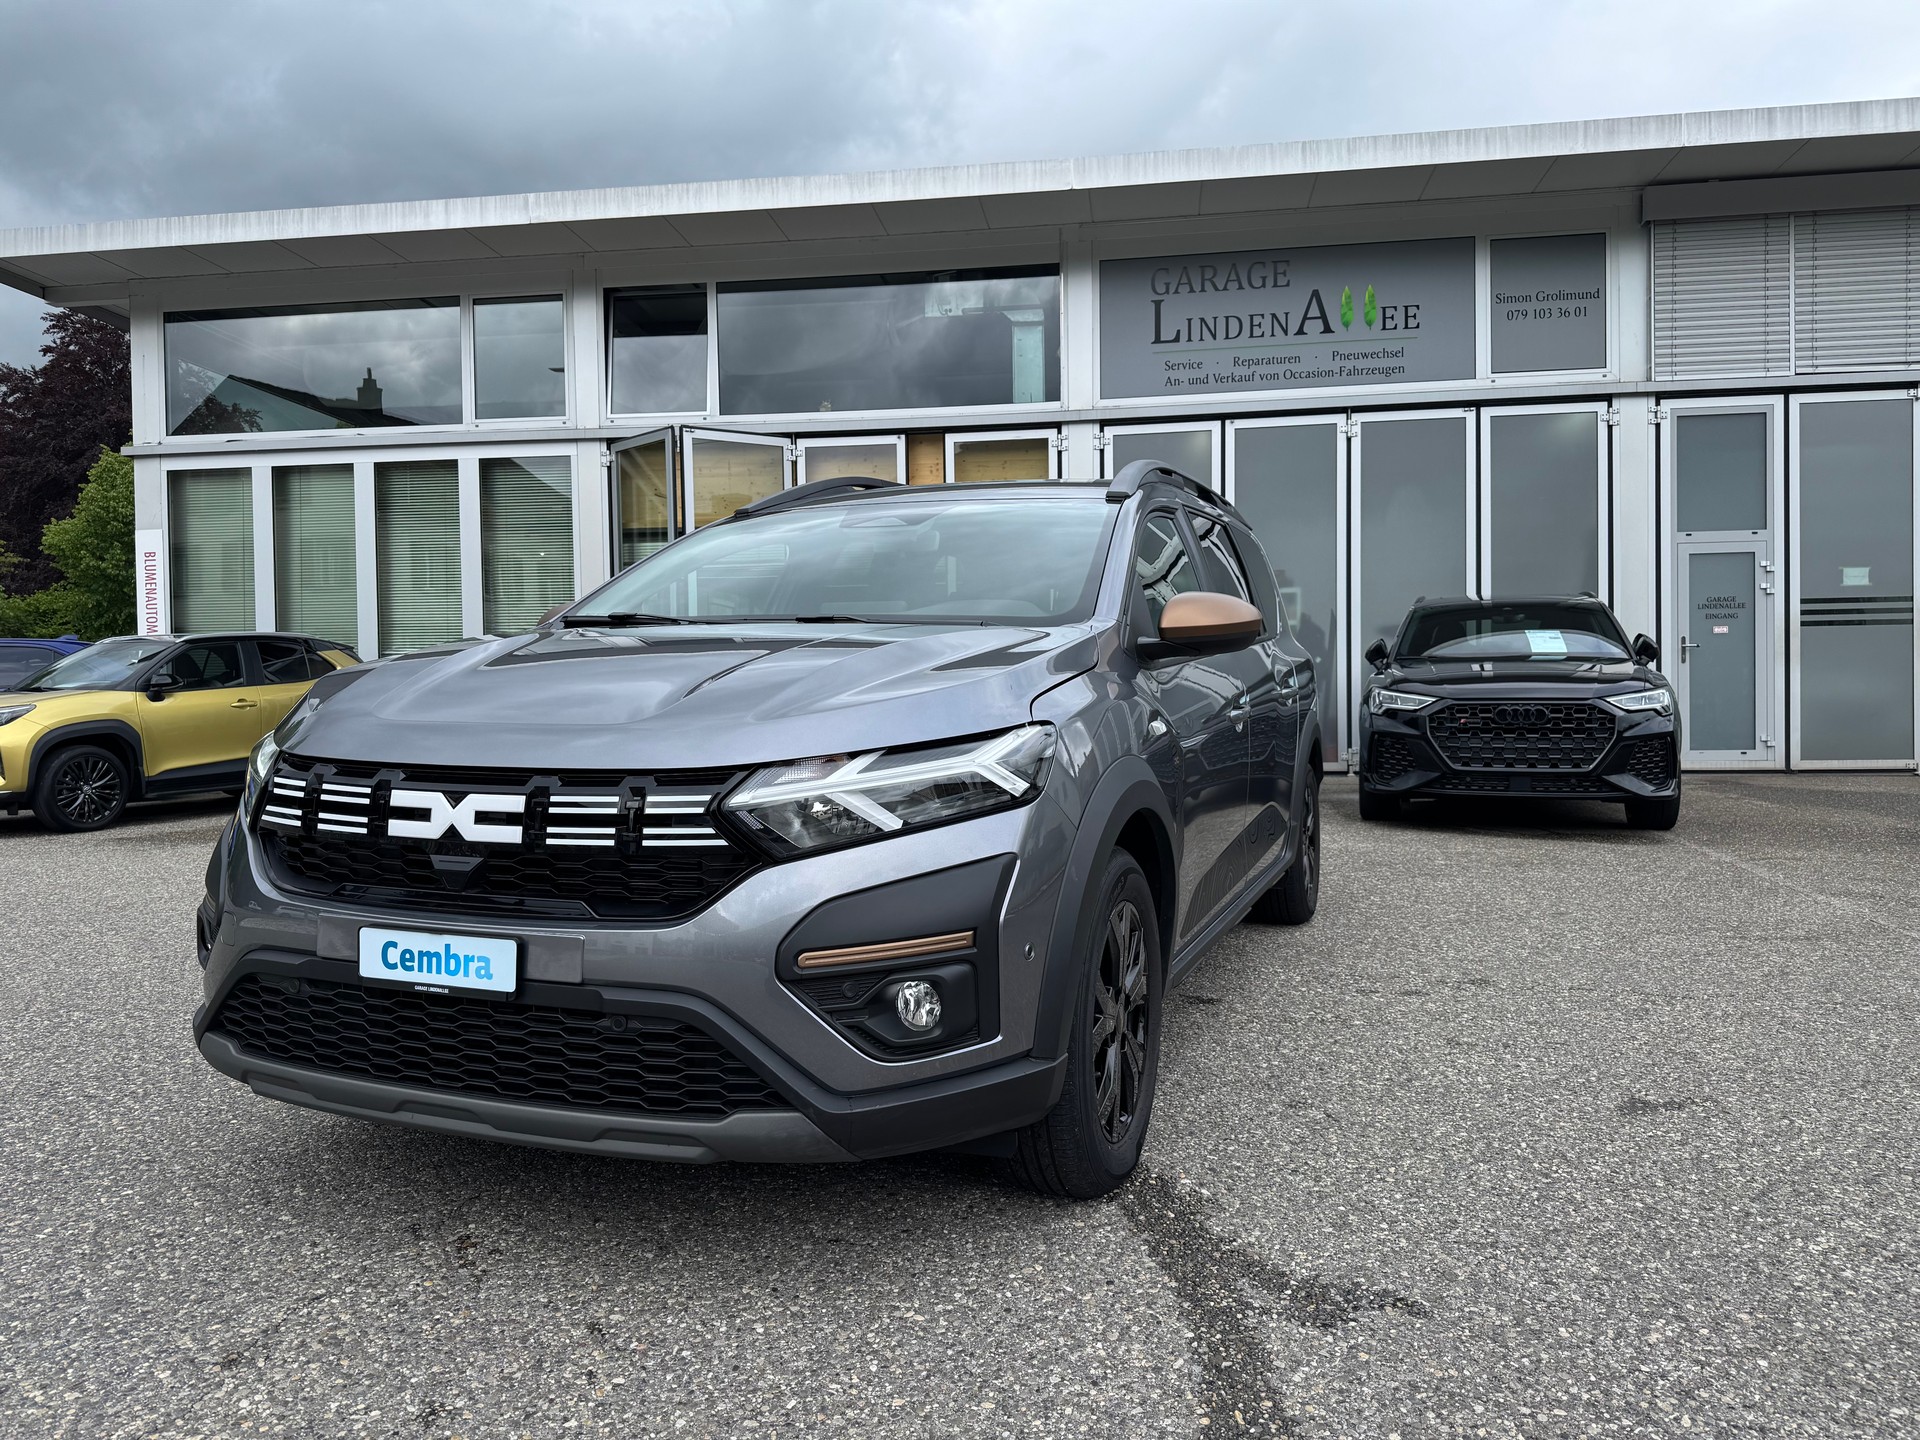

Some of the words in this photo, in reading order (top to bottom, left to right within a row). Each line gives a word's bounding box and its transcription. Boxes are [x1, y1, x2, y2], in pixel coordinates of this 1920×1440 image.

[1151, 260, 1291, 295] GARAGE
[1495, 293, 1532, 304] Simon
[1535, 288, 1600, 302] Grolimund
[1506, 309, 1528, 321] 079
[1533, 308, 1553, 320] 103
[1557, 307, 1571, 319] 36
[1574, 306, 1588, 317] 01
[1164, 359, 1203, 371] Service
[1233, 354, 1301, 369] Reparaturen
[1332, 347, 1404, 361] Pneuwechsel
[1164, 376, 1185, 387] An-
[1188, 374, 1209, 386] und
[1213, 371, 1257, 384] Verkauf
[1259, 372, 1280, 381] von
[1283, 365, 1405, 381] Occasion-Fahrzeugen
[144, 551, 158, 634] BLUMENAUTOM
[1697, 602, 1747, 610] LINDENALLEE
[1705, 612, 1739, 620] EINGANG
[381, 940, 493, 980] Cembra
